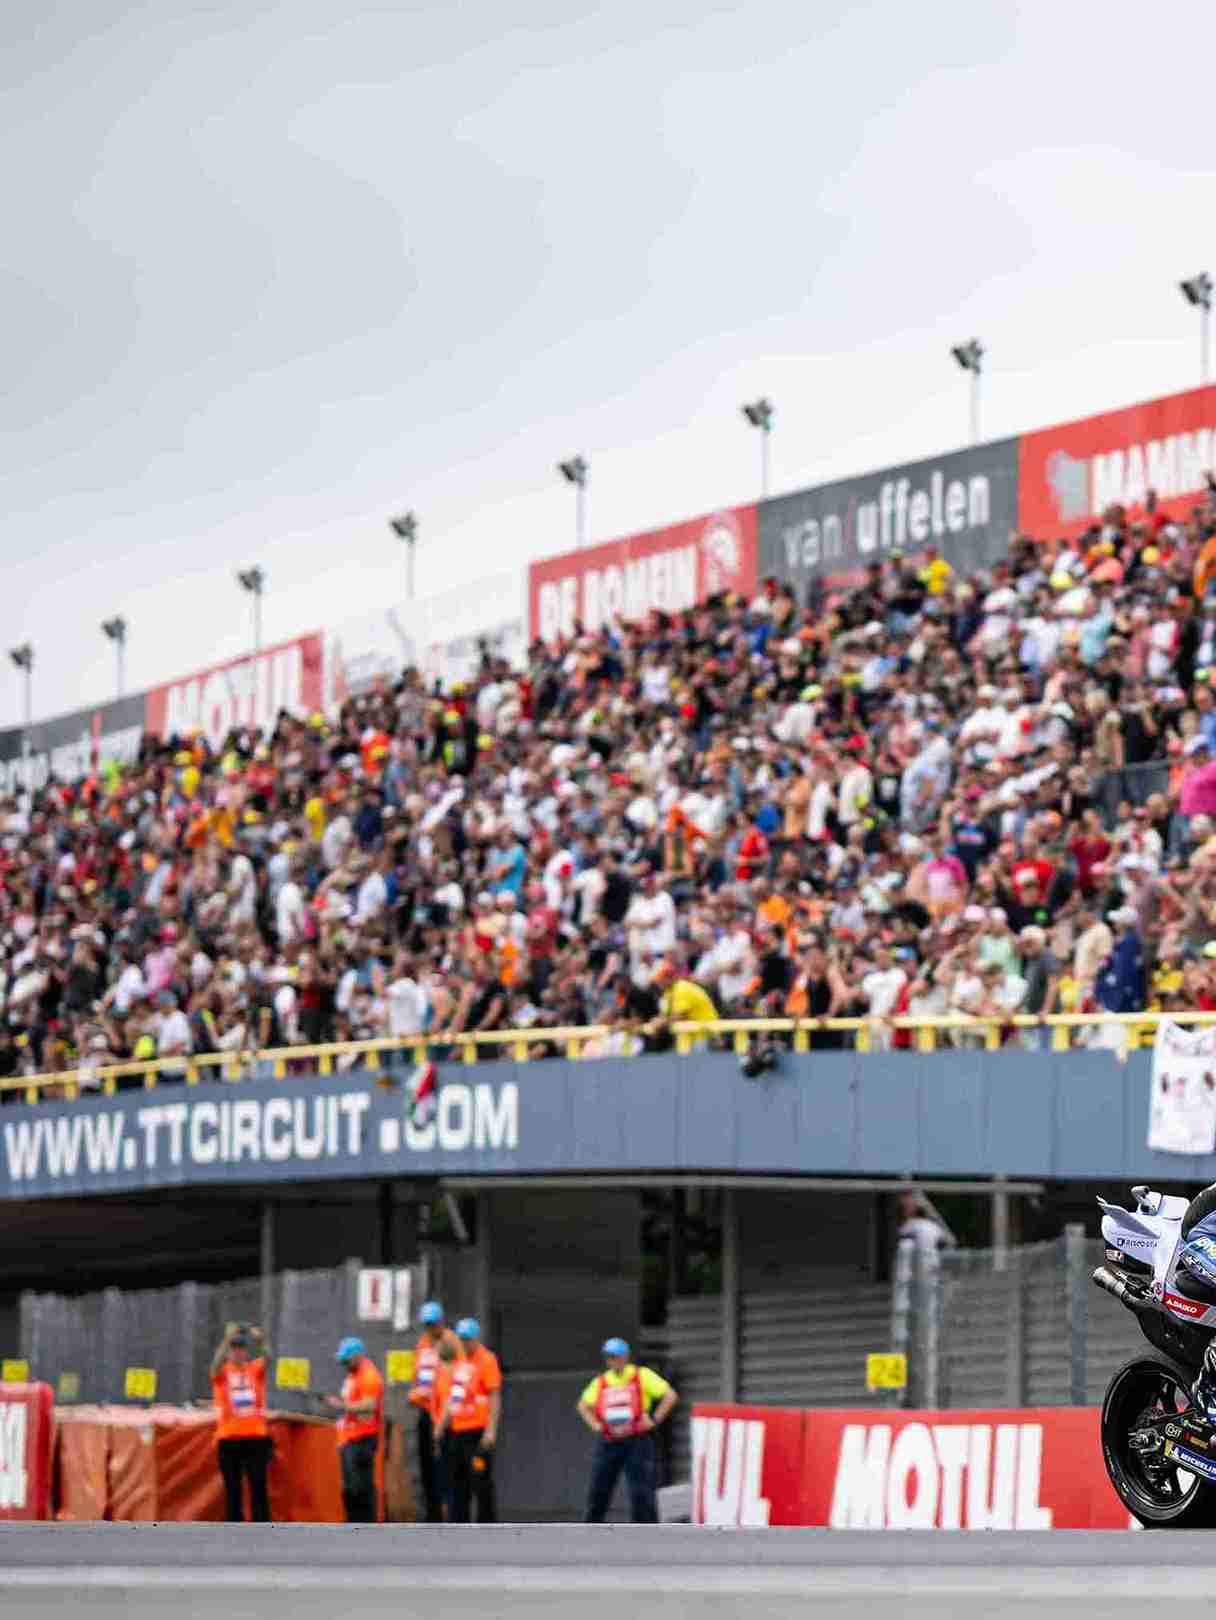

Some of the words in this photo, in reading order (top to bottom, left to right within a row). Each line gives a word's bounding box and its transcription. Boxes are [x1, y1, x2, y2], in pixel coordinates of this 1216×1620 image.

[784, 514, 843, 567] van
[856, 471, 989, 553] uffelen
[830, 1422, 1053, 1530] MOTUL
